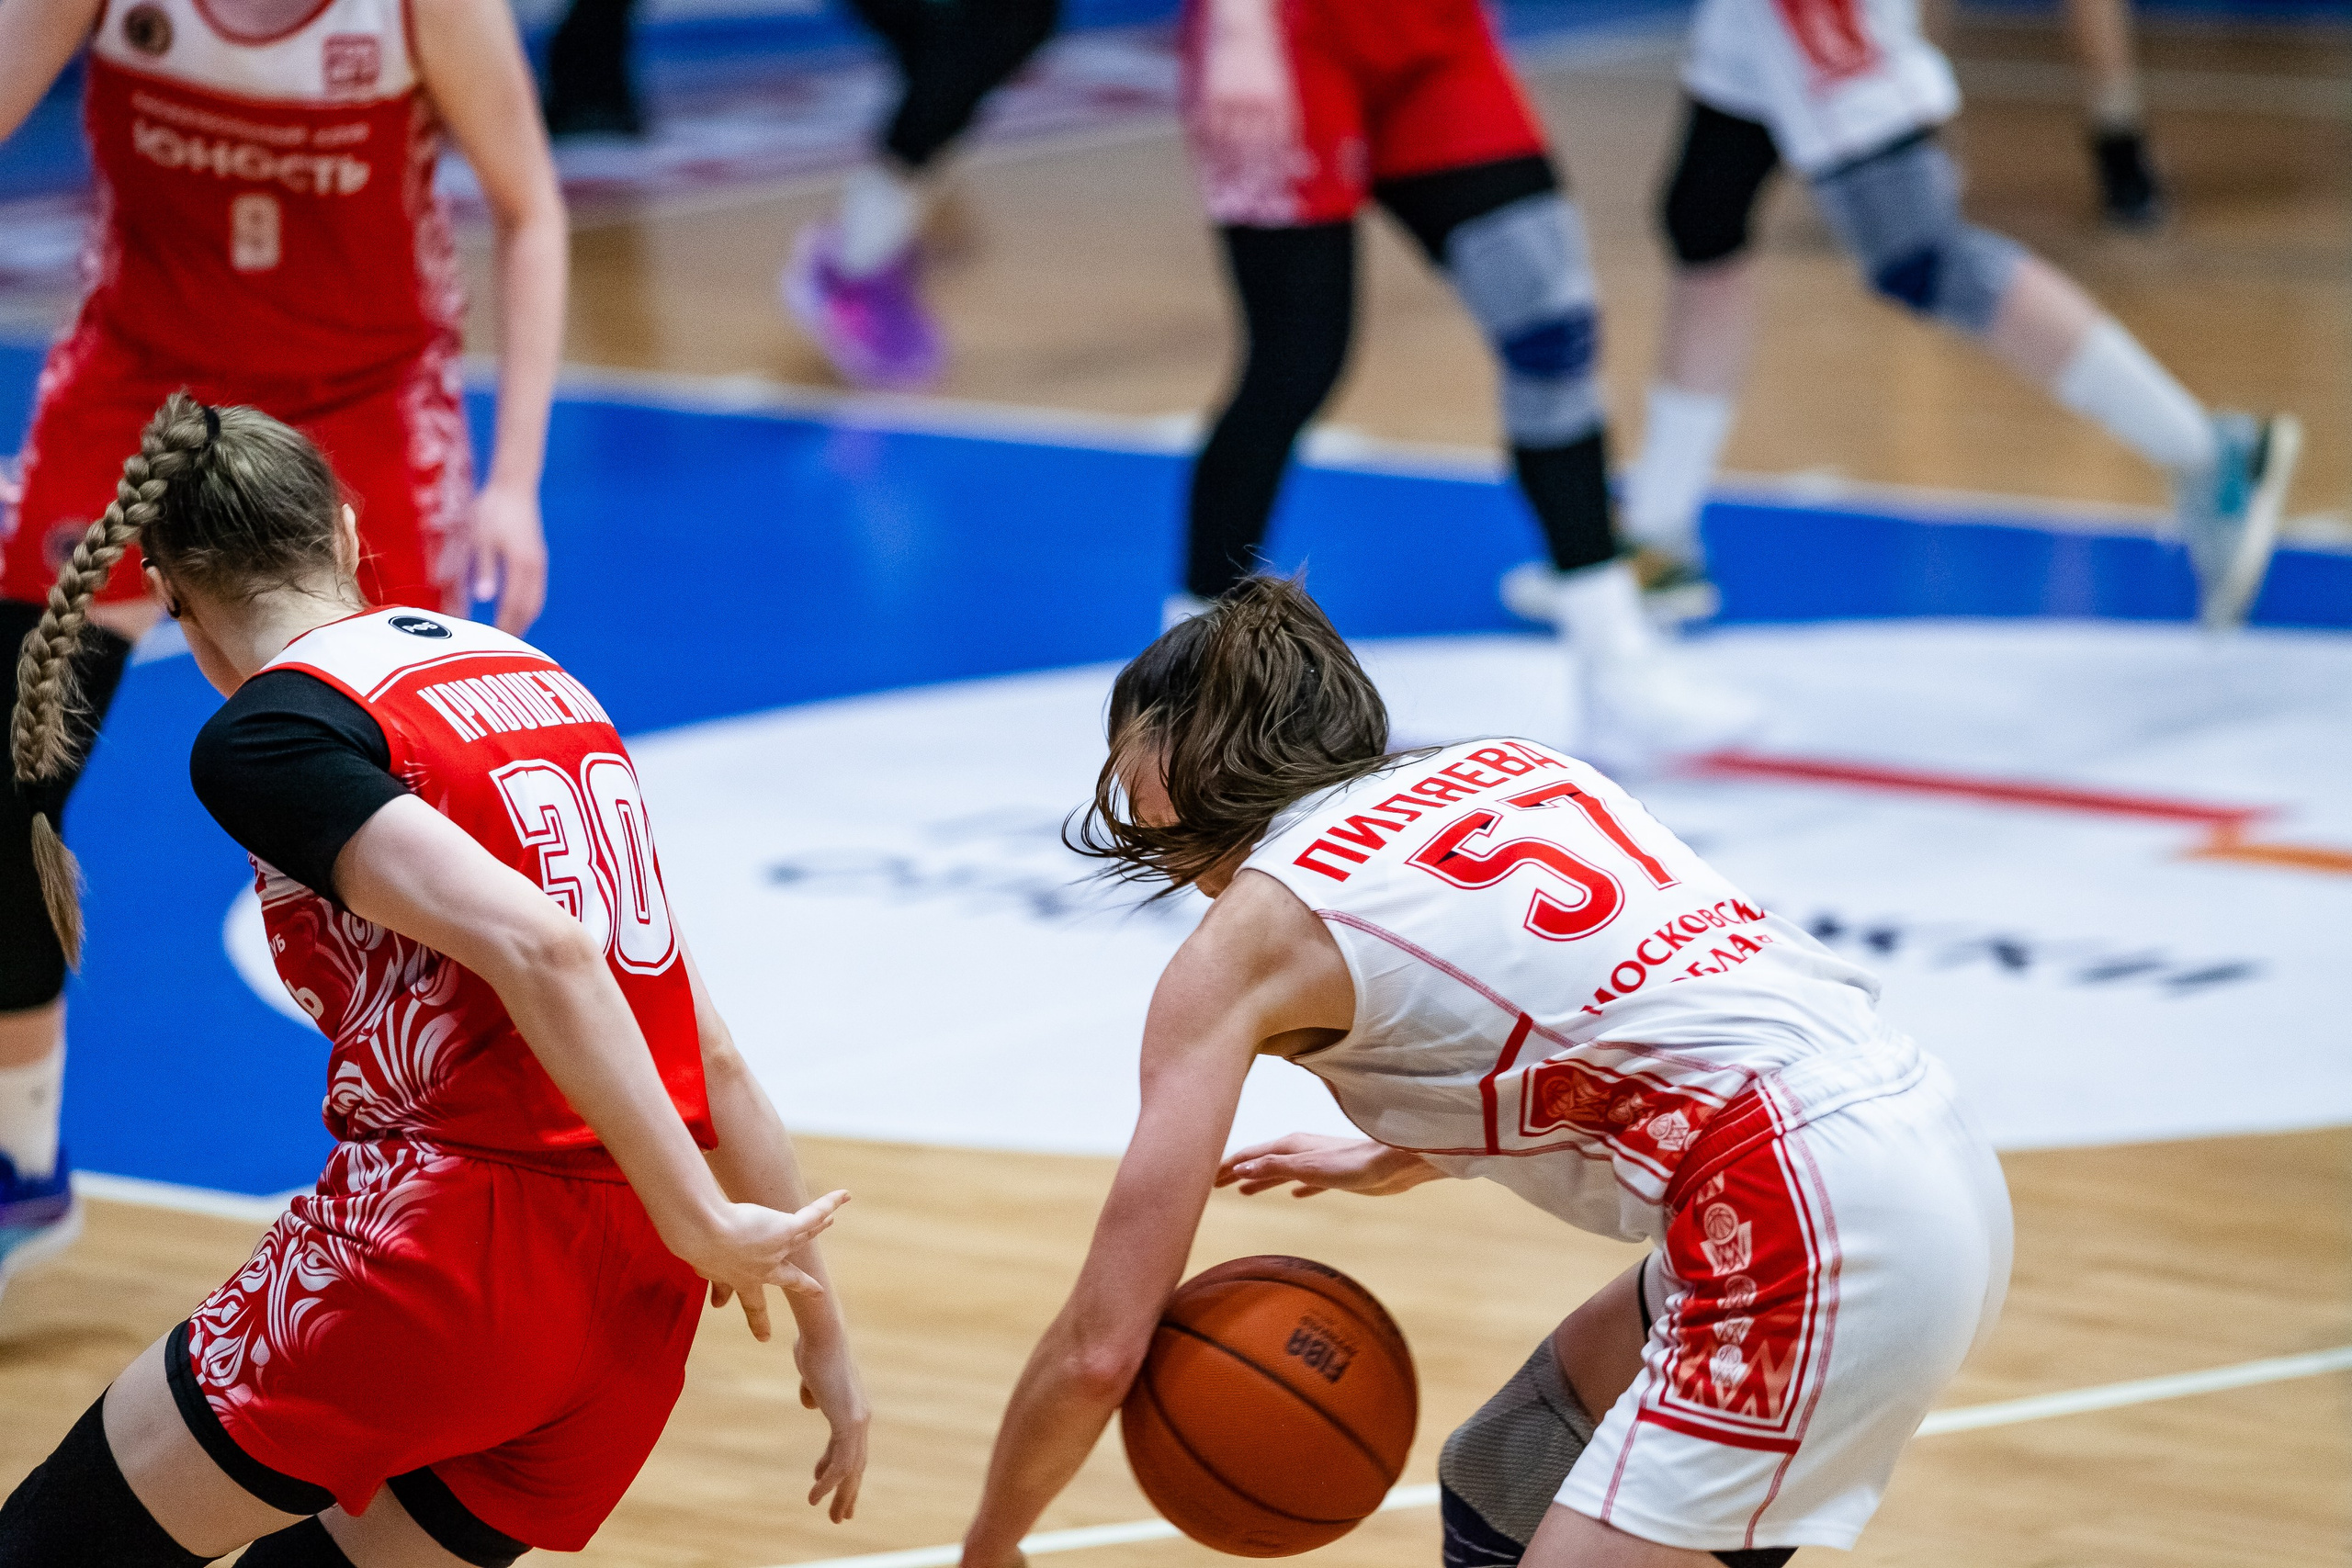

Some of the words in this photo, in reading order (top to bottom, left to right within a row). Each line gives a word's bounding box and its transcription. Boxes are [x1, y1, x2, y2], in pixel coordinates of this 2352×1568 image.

[489, 751, 680, 976] 30
[1293, 741, 1568, 883] ПИЛЯЕВА
[1404, 780, 1682, 942] 57
